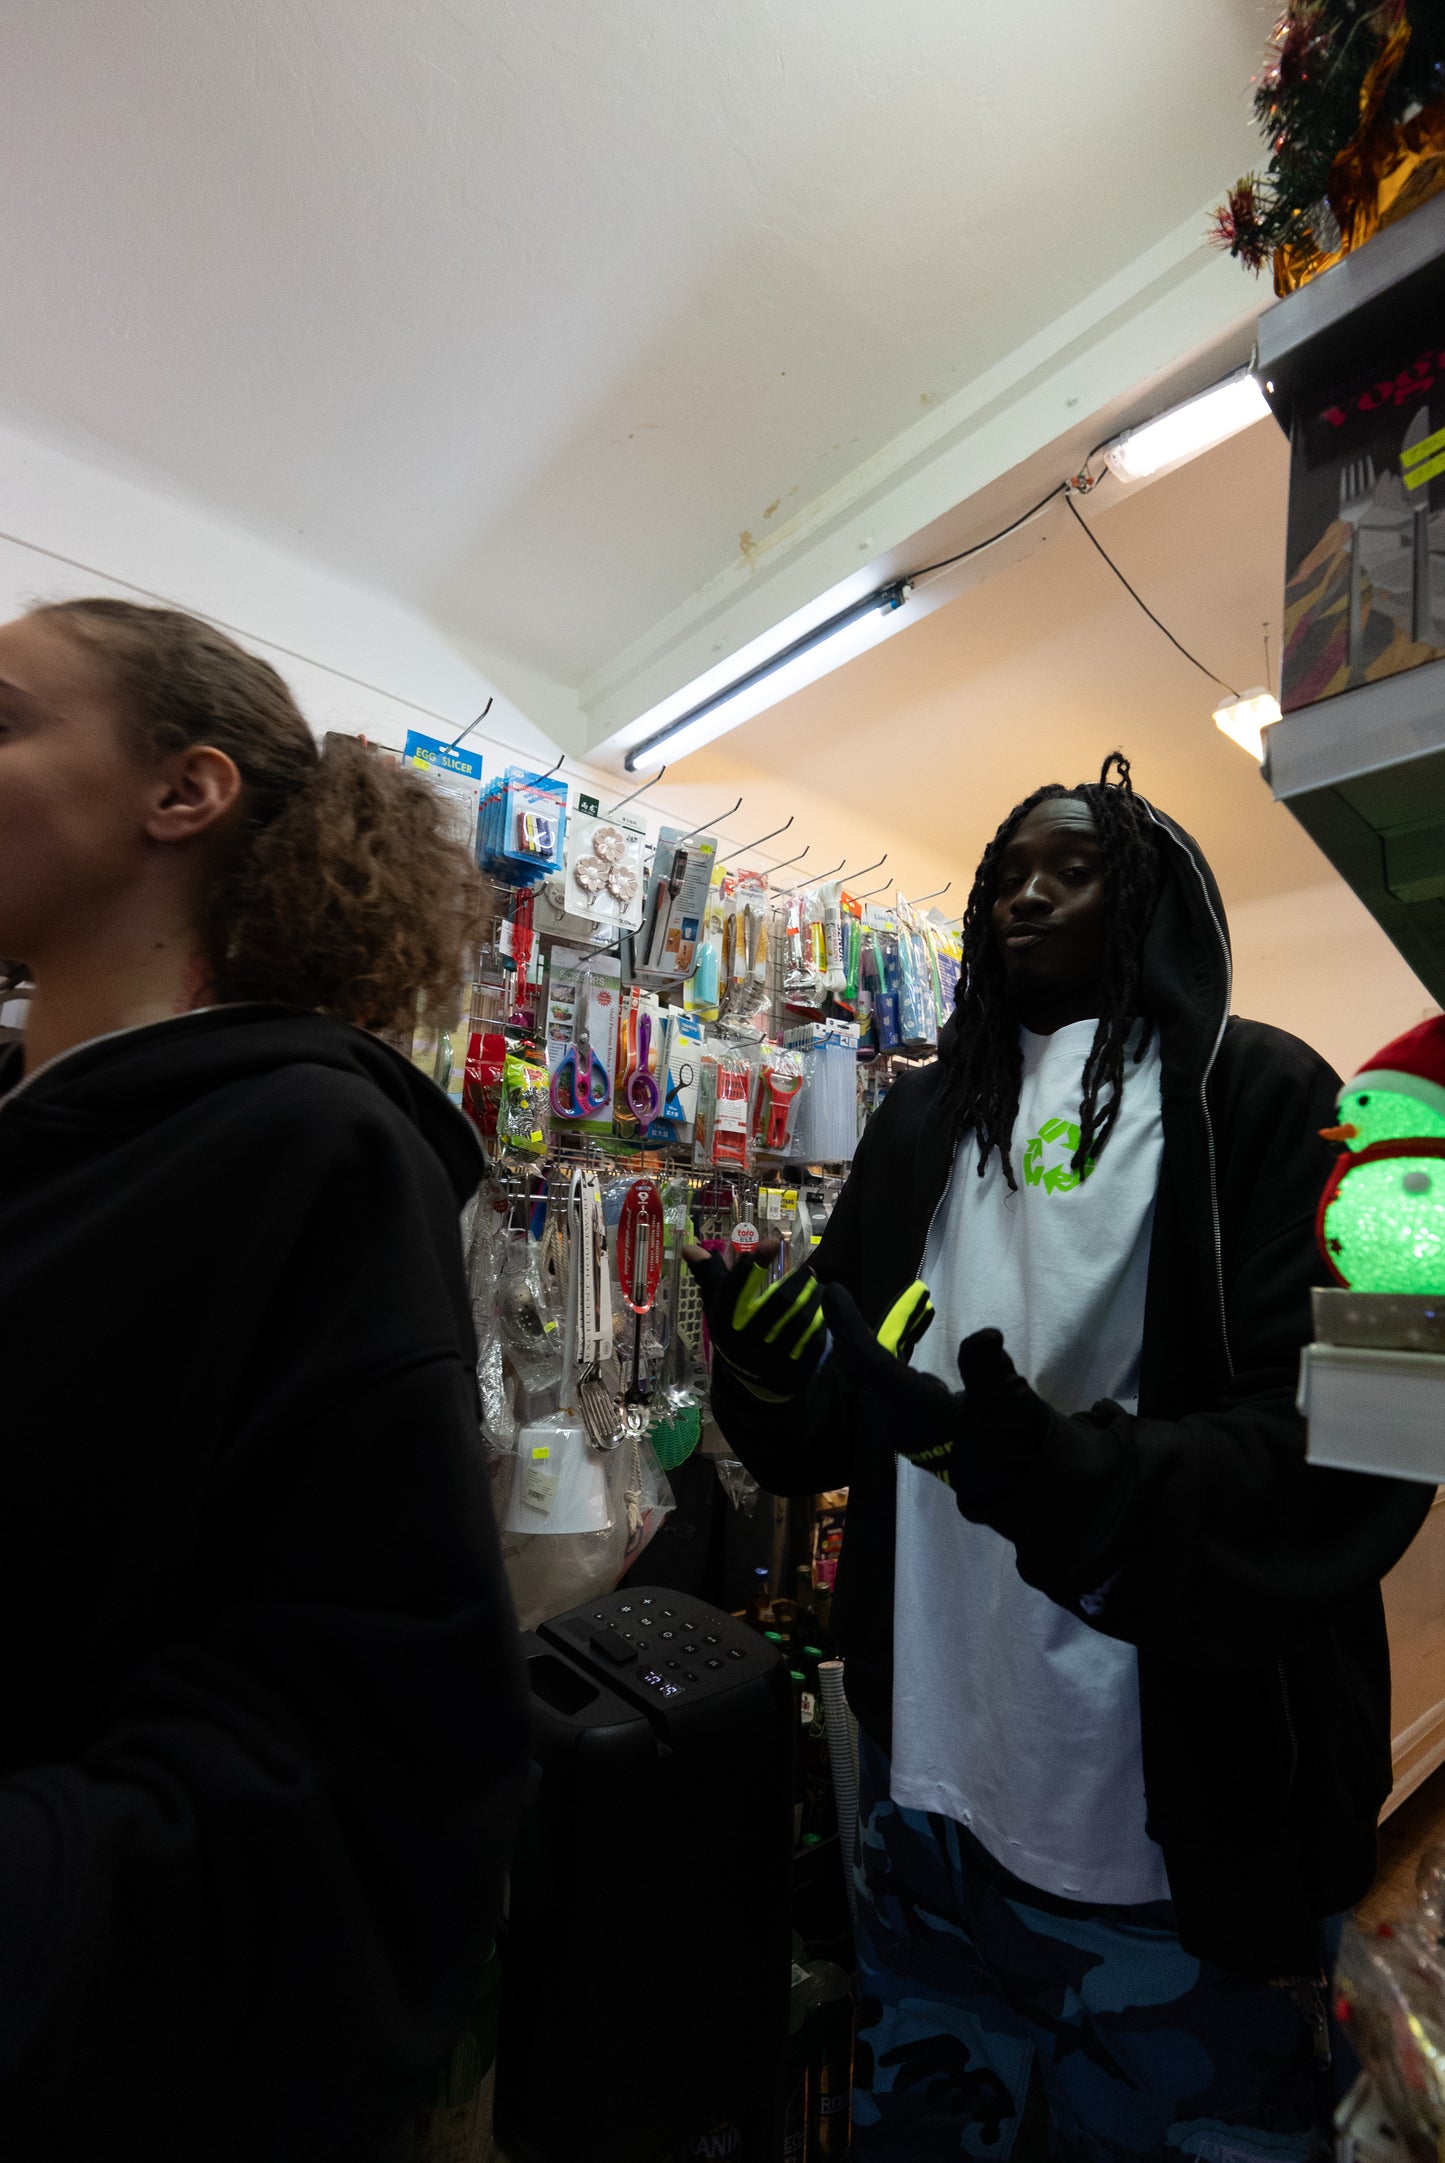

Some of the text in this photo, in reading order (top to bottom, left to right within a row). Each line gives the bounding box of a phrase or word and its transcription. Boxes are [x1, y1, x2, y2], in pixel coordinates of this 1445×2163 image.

[416, 747, 473, 774] EGG SLICER
[560, 969, 606, 986] SCISSRS
[737, 1229, 755, 1237] toro
